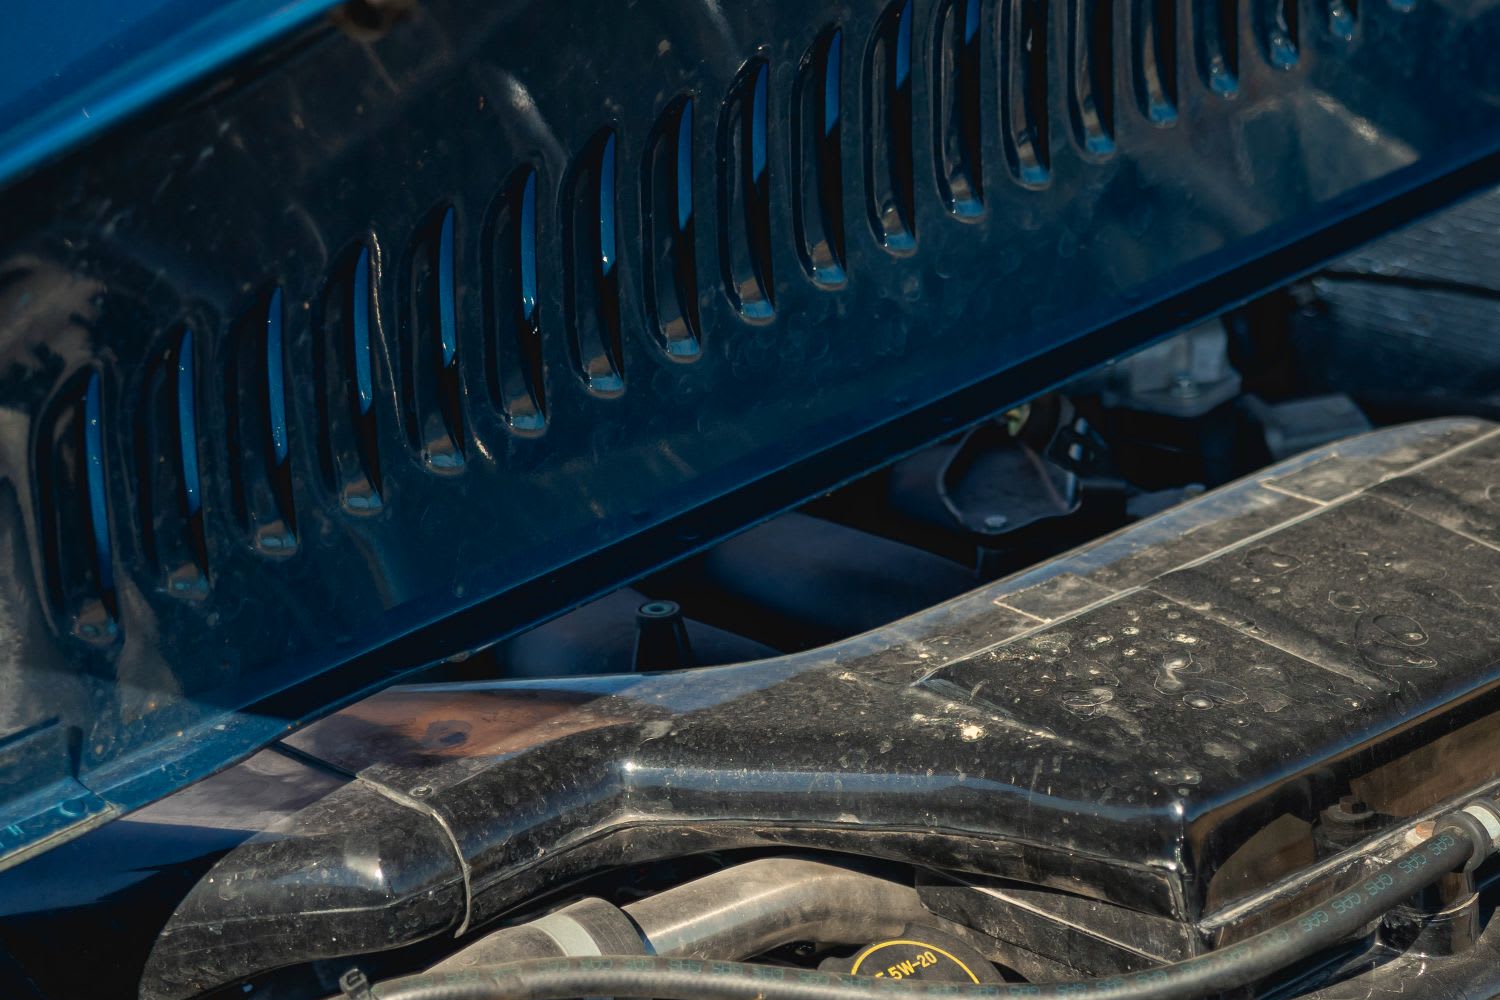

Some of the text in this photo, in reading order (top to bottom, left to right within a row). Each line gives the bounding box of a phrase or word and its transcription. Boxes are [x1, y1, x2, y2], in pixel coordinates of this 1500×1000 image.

[1427, 835, 1455, 856] GAS
[1397, 852, 1427, 874] GAS
[1364, 873, 1393, 896] GAS
[1332, 892, 1362, 914] GAS
[1299, 910, 1329, 933] GAS
[887, 951, 937, 979] 5W-20
